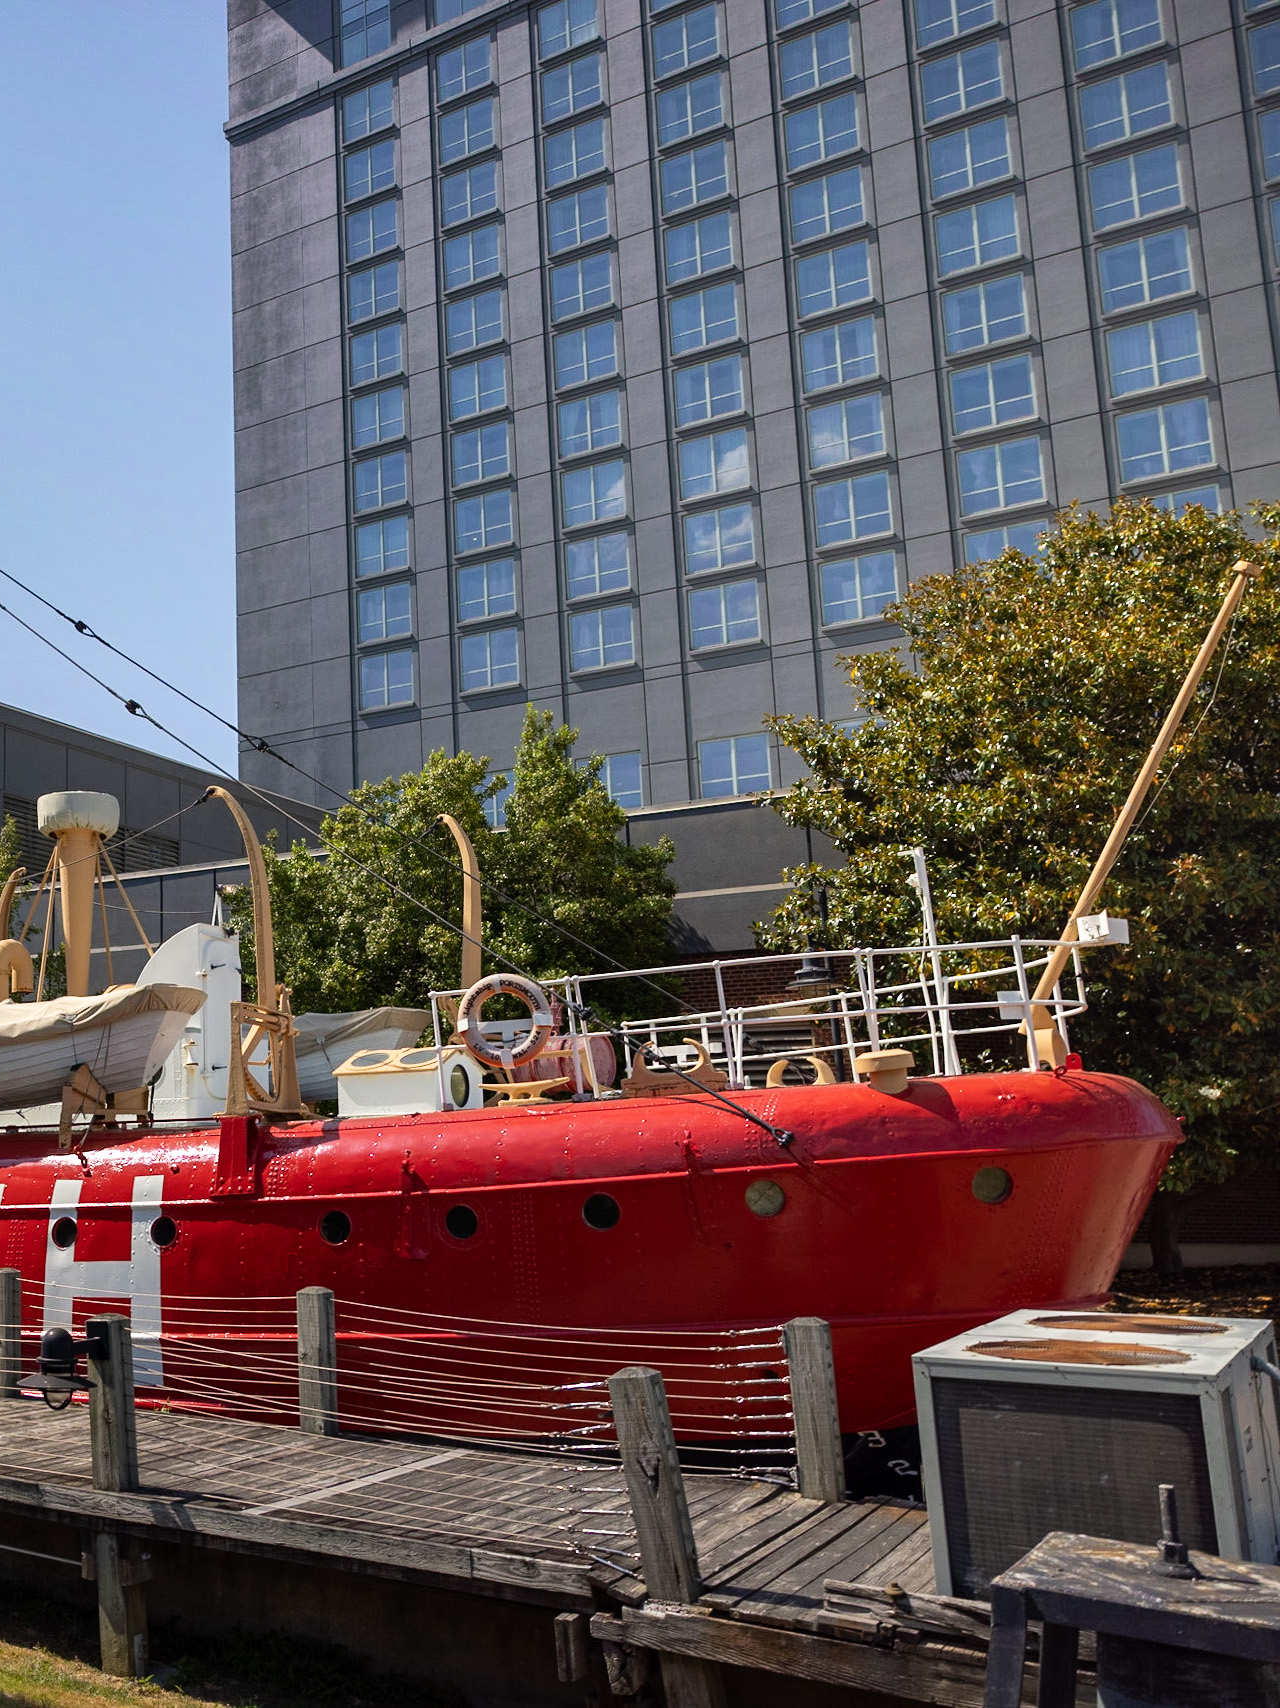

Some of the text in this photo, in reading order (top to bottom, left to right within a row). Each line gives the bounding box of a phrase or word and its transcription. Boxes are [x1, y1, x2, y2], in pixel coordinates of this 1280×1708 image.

[463, 979, 542, 1016] Lightship PORTSMOUTH
[887, 1460, 919, 1476] 2
